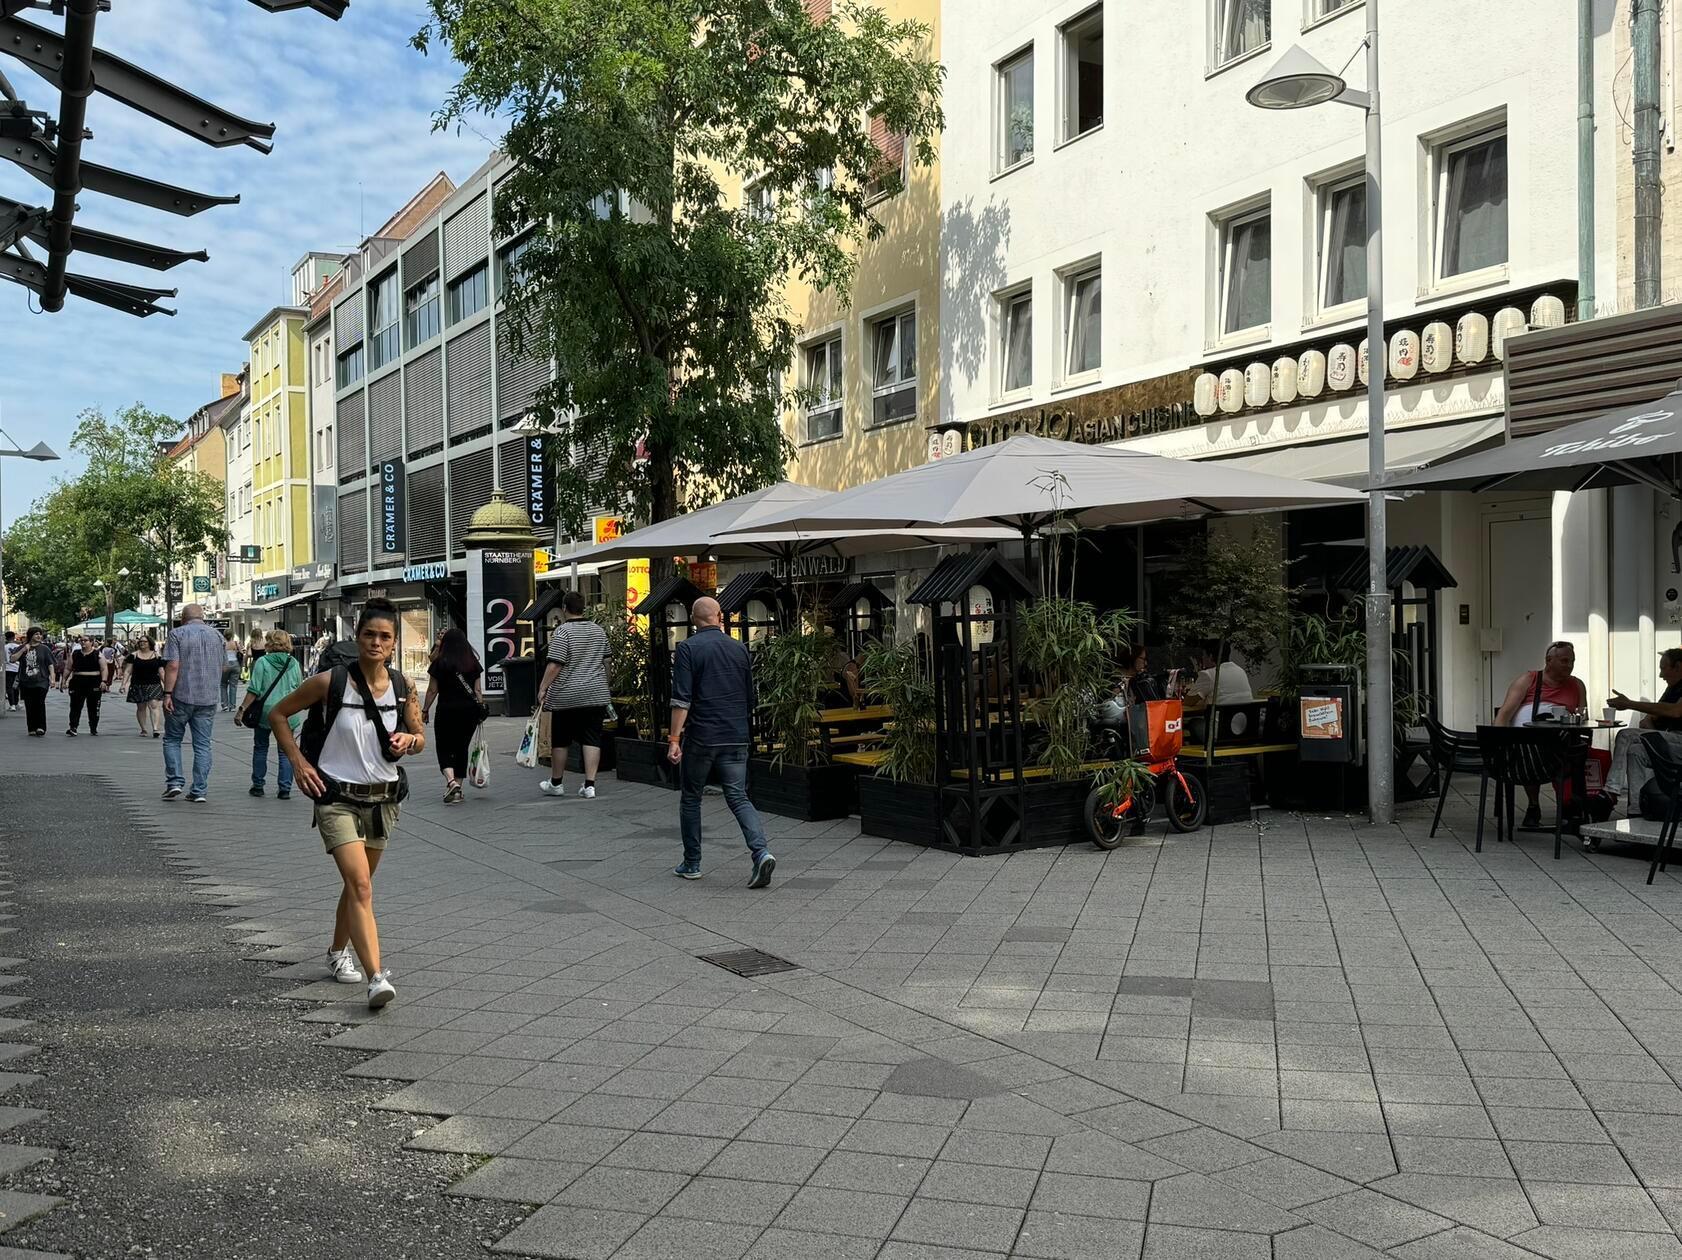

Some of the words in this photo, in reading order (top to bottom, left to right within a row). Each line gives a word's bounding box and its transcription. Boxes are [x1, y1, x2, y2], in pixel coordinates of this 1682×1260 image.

[1074, 414, 1123, 443] ASIAN
[1127, 400, 1199, 433] CUISINE
[530, 438, 542, 449] &
[1539, 432, 1676, 457] Tchibo
[384, 464, 394, 482] CO
[385, 485, 395, 493] &
[531, 453, 544, 523] CRÄMER
[385, 496, 395, 550] CRÄMER
